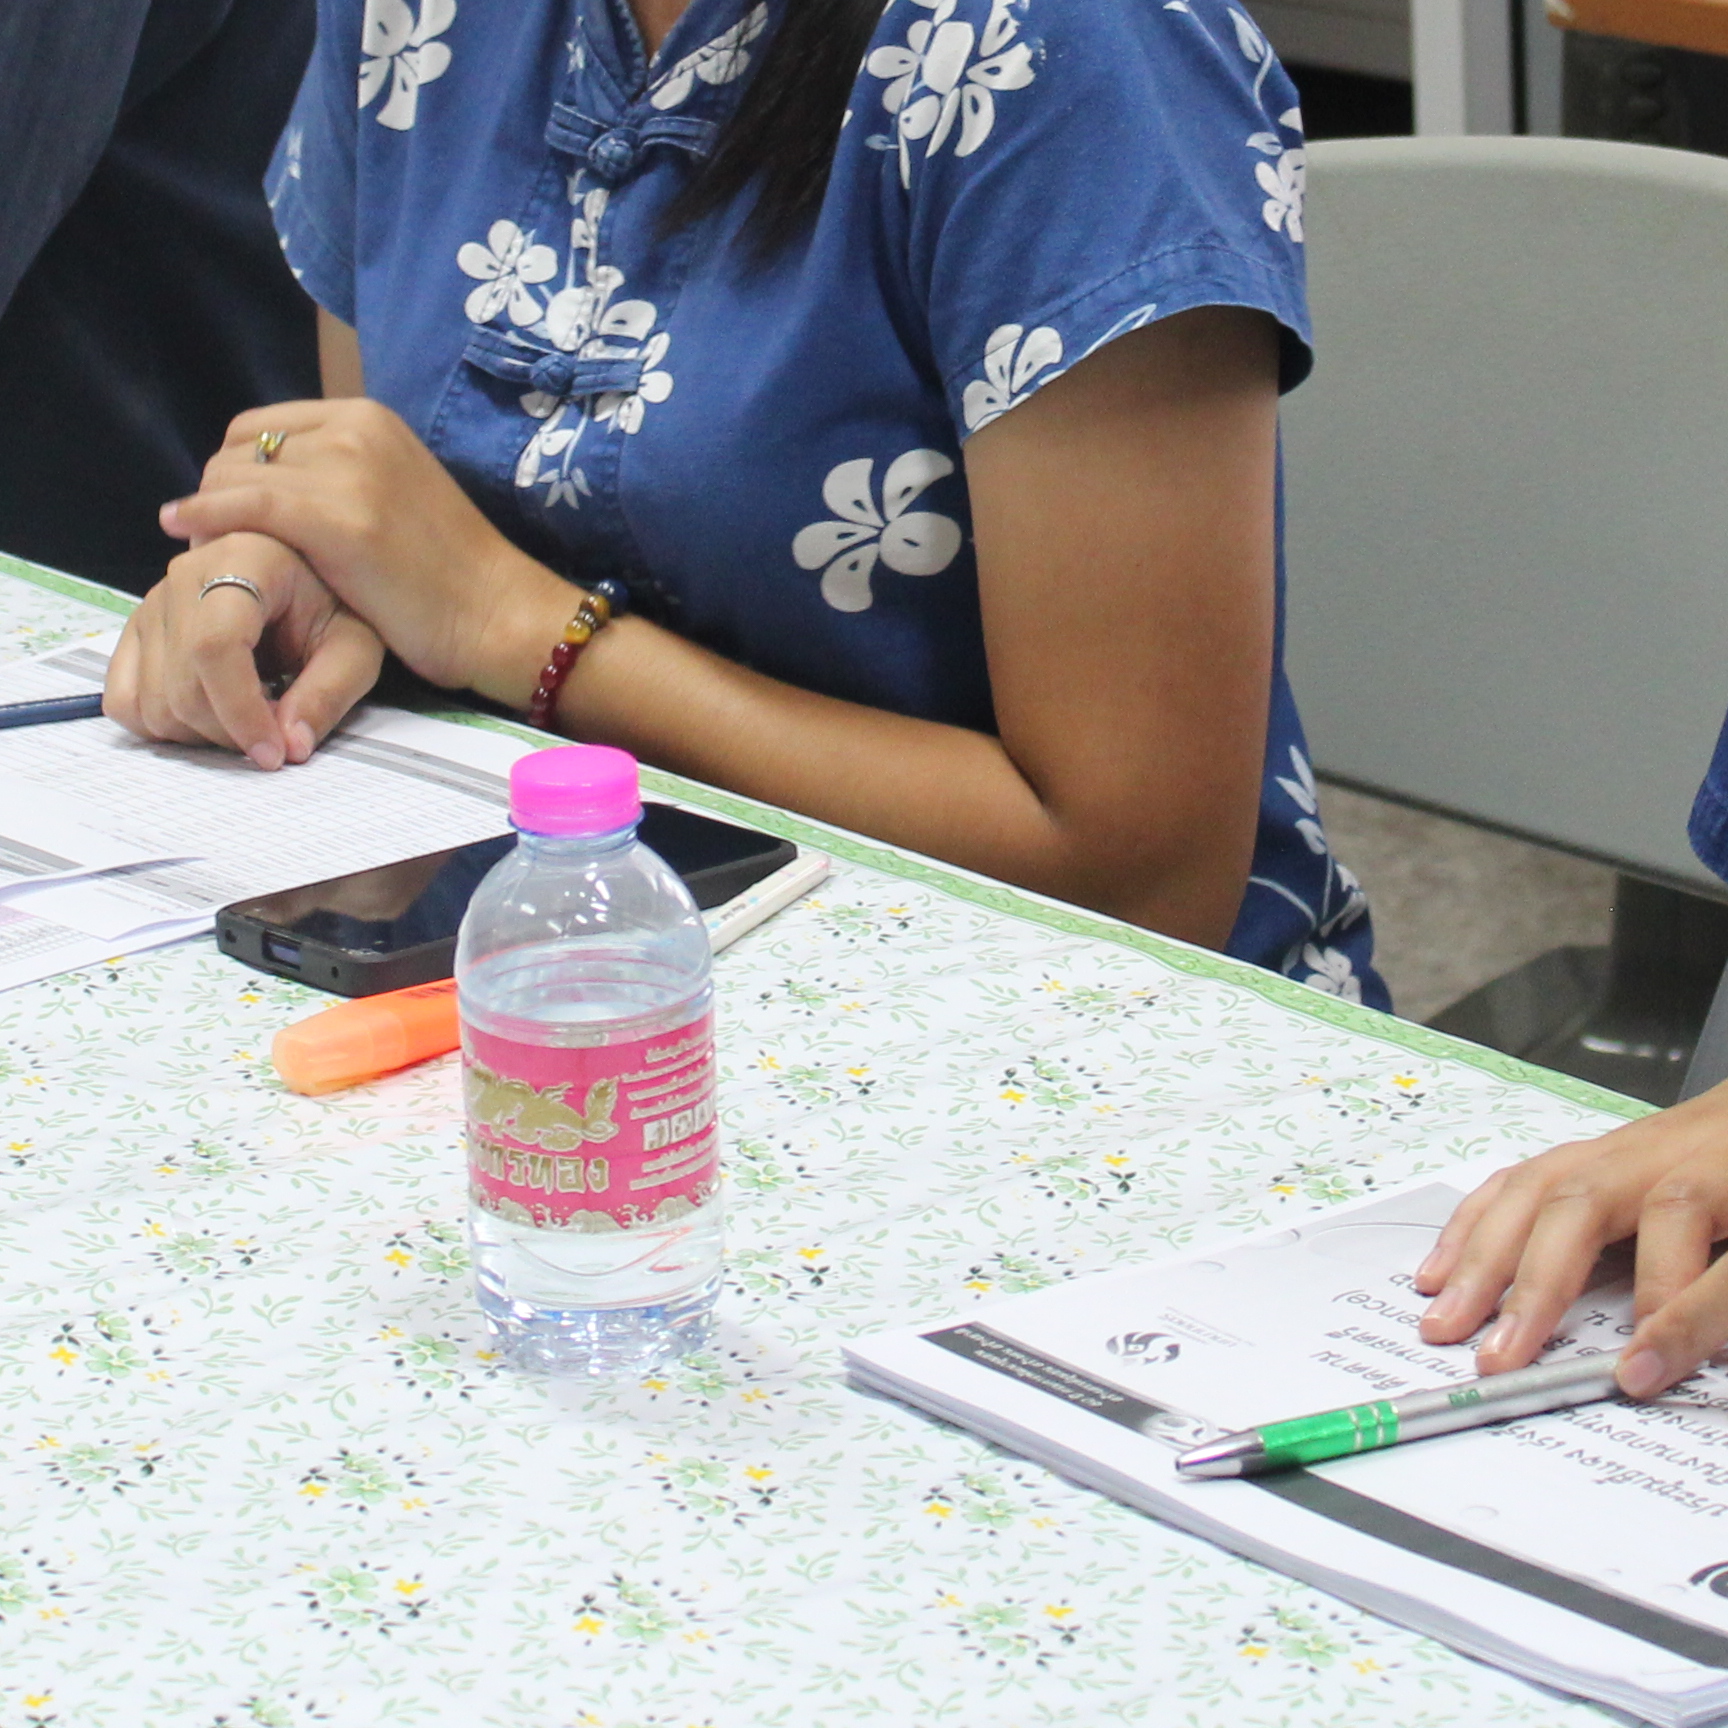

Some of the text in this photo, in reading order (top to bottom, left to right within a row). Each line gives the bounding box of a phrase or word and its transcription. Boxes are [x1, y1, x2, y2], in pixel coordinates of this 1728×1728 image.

[1310, 1349, 1409, 1390] ติดตาม
[1489, 1421, 1565, 1449] เร่งรั
